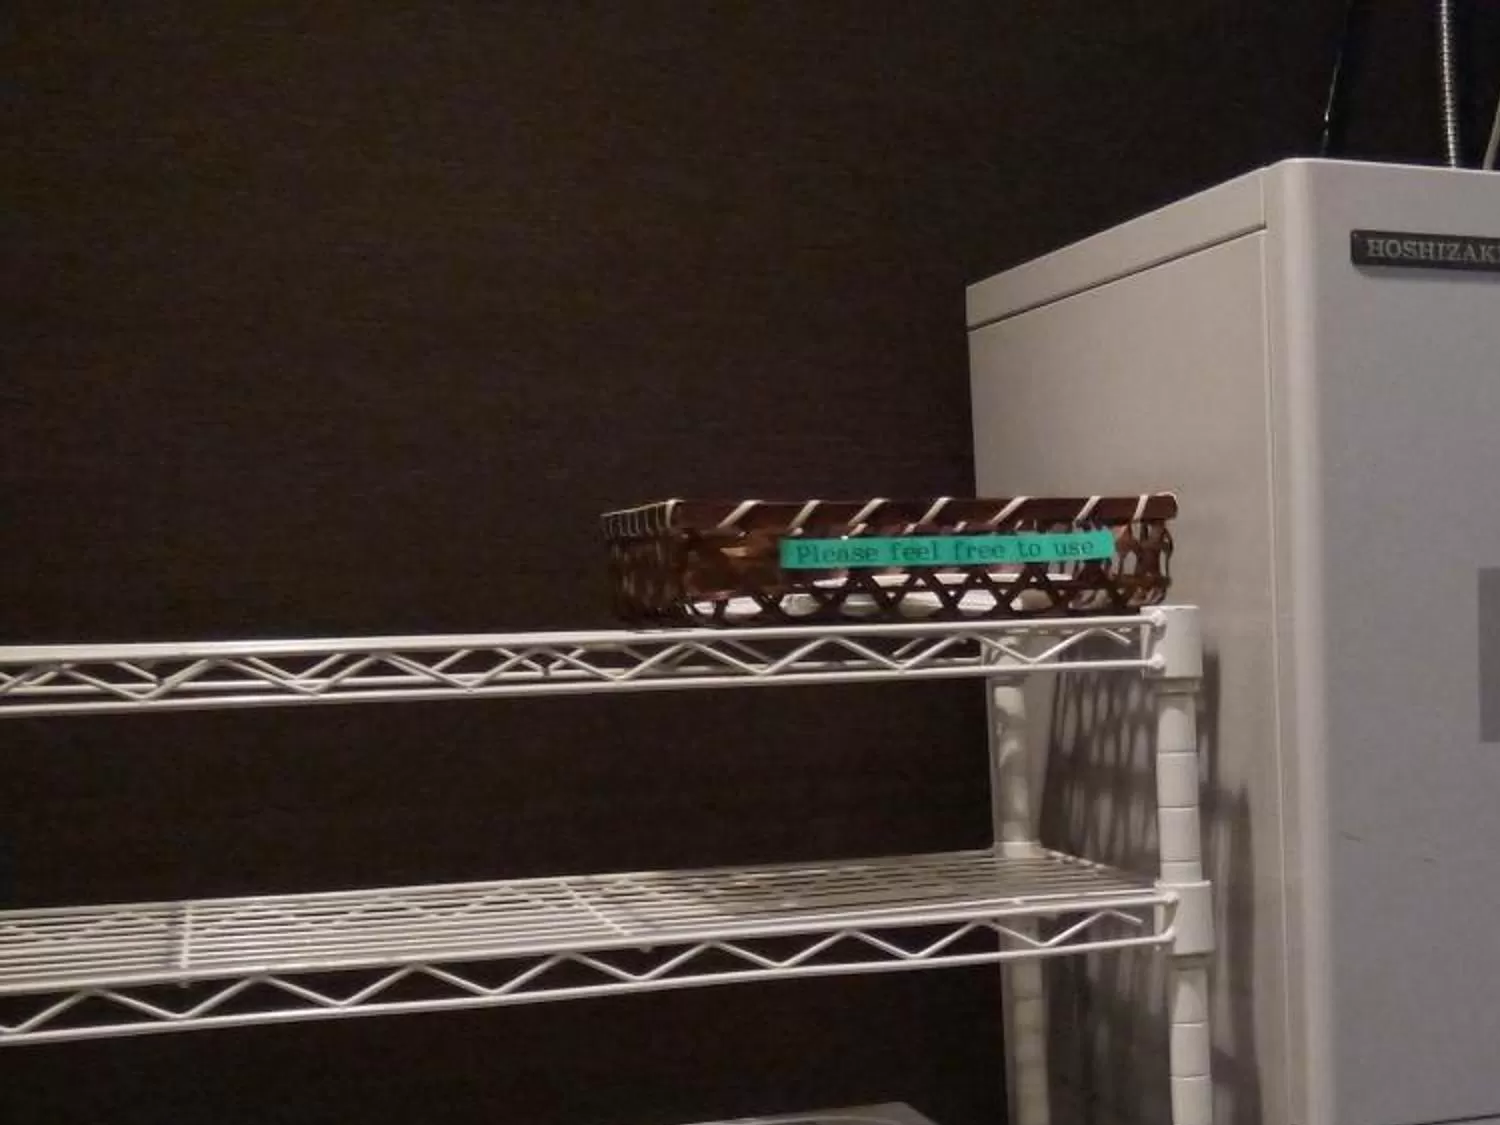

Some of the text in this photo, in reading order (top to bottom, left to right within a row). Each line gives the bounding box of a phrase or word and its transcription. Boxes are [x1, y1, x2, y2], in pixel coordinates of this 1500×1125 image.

[798, 539, 1094, 565] Please feel free to use
